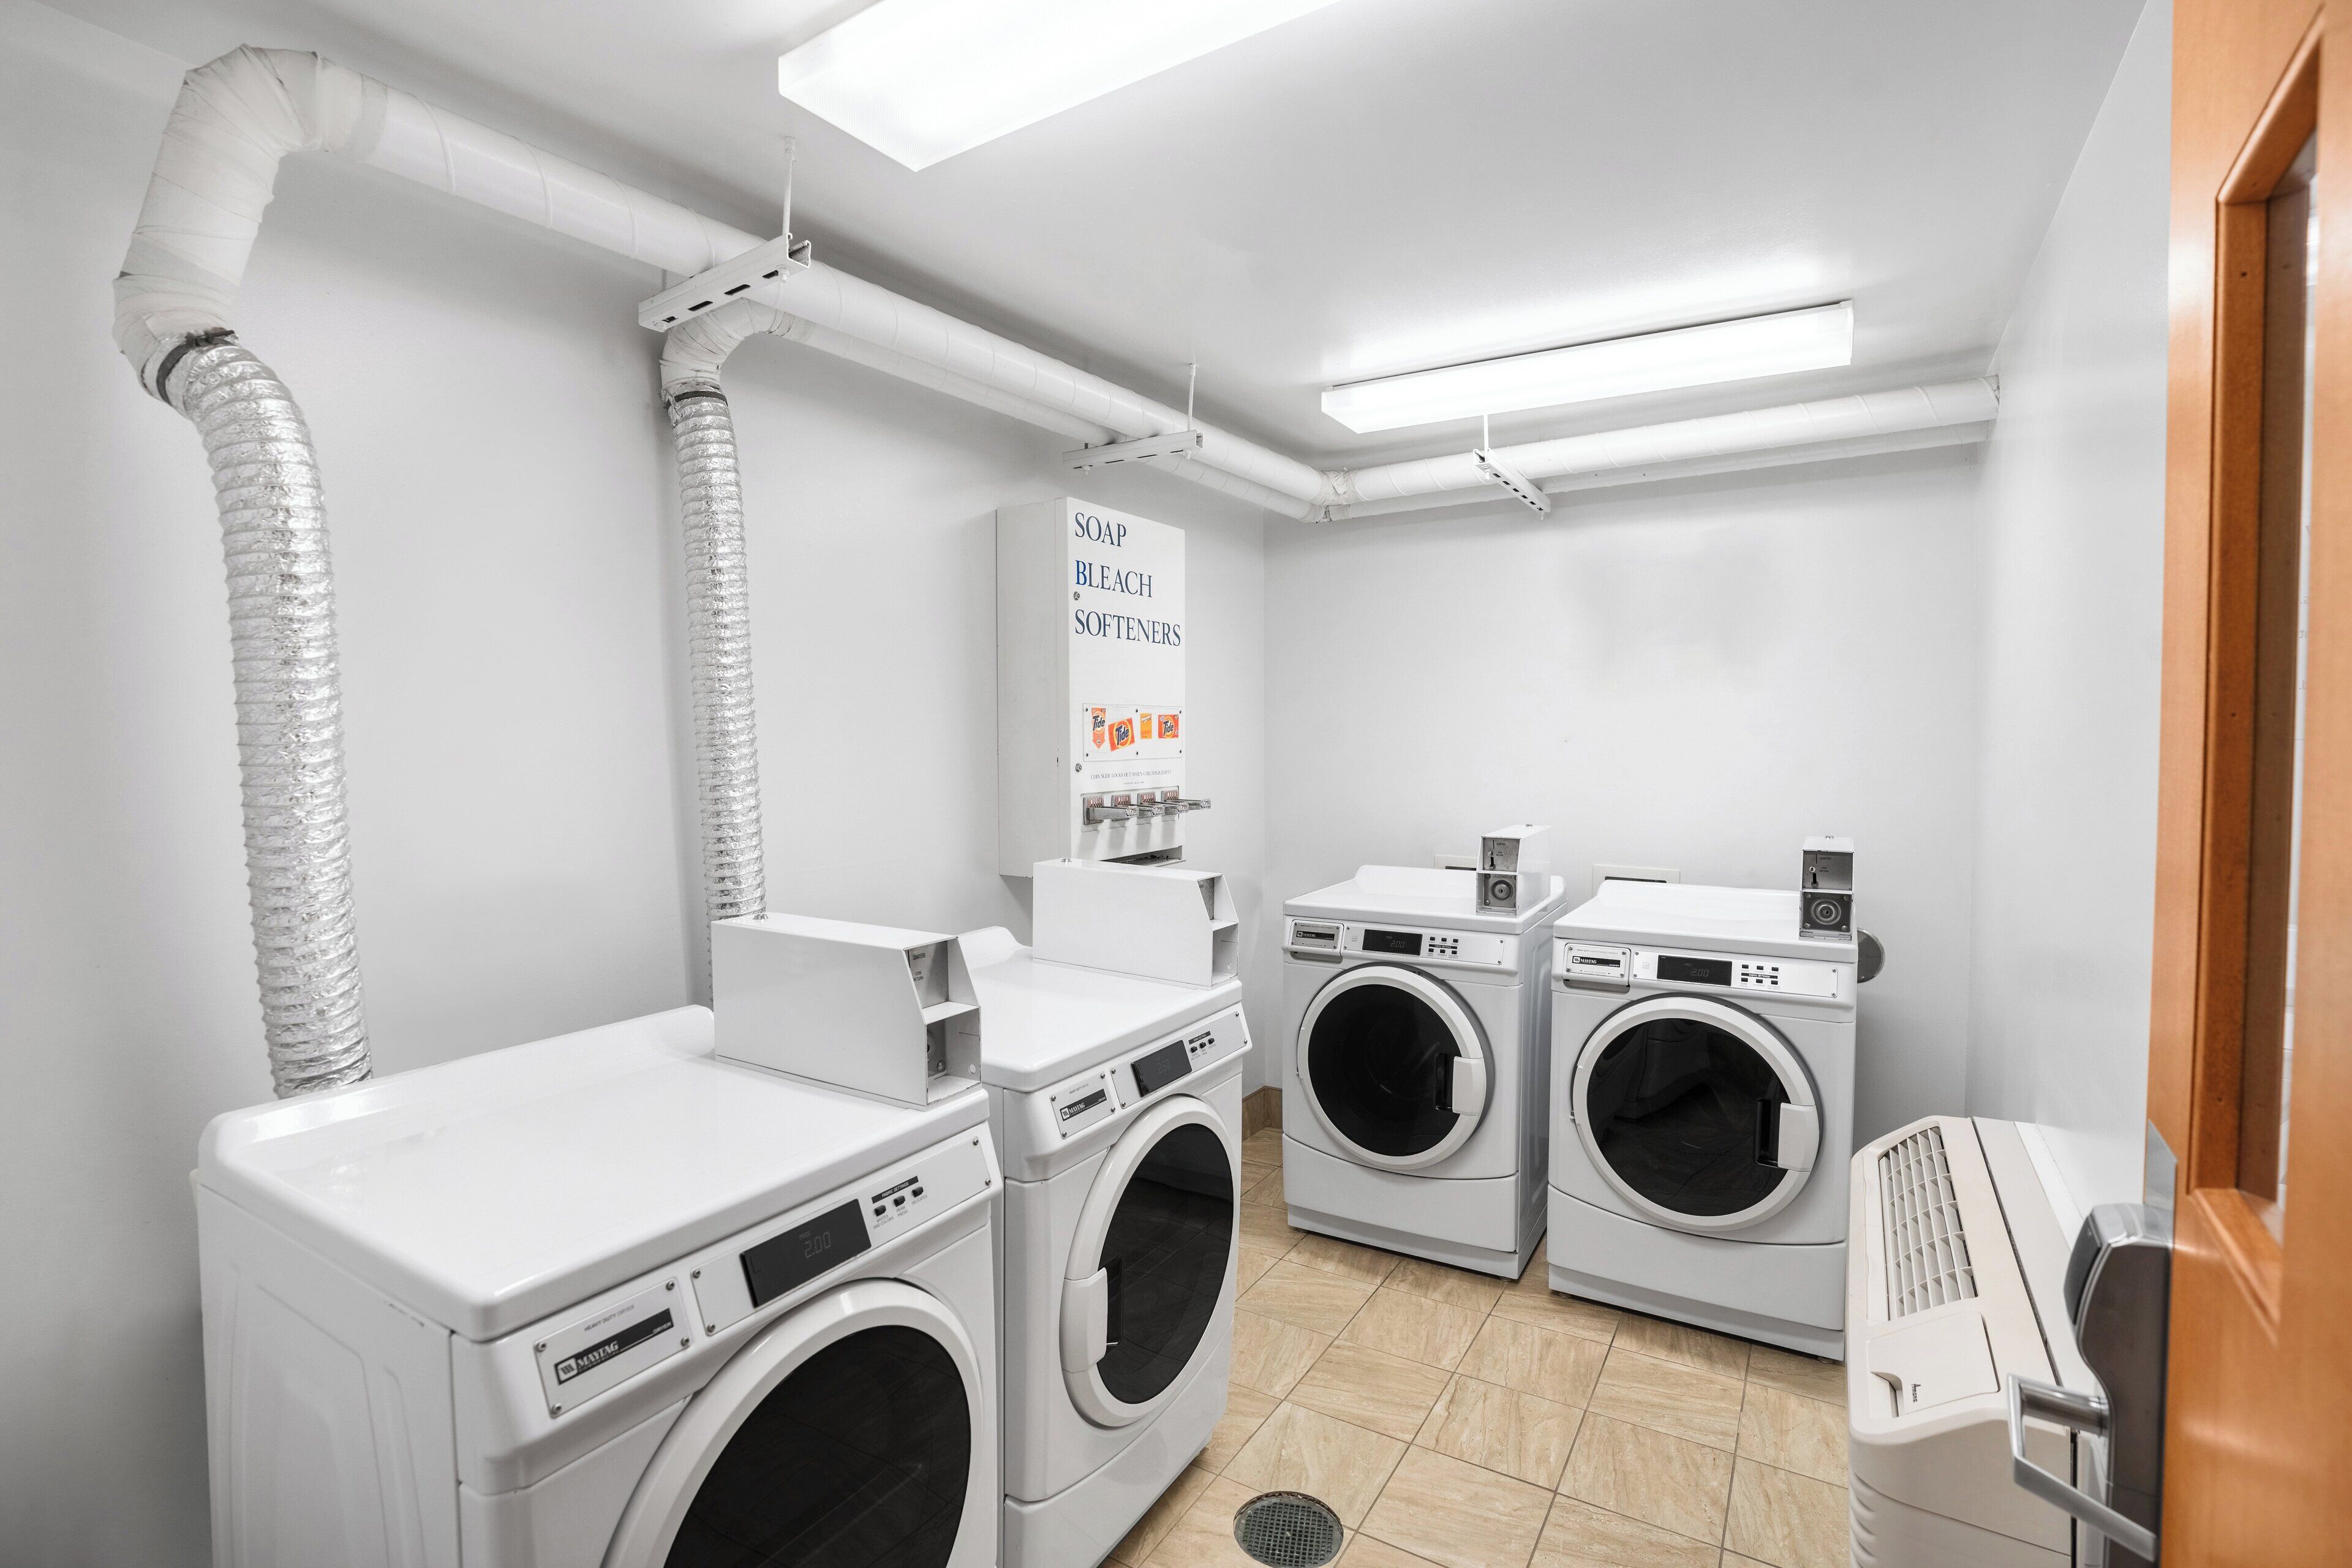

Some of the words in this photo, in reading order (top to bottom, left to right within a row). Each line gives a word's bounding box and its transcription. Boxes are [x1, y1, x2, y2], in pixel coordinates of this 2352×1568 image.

[1075, 512, 1126, 547] SOAP
[1075, 560, 1152, 598] BLEACH
[1075, 609, 1181, 646] SOFTENERS
[1093, 715, 1105, 731] Tide
[1163, 720, 1174, 736] Tide
[1115, 725, 1129, 745] Tide
[1069, 1102, 1085, 1114] MAYTAG
[882, 1189, 894, 1197] FABRIC
[894, 1182, 909, 1191] SETTINGS
[911, 1194, 927, 1205] DELICATES
[880, 1216, 894, 1226] COLORS
[584, 1320, 601, 1332] HEAVY
[653, 1321, 672, 1334] DRYER
[577, 1340, 619, 1367] MAYTAG
[1911, 1384, 1921, 1403] Amana
